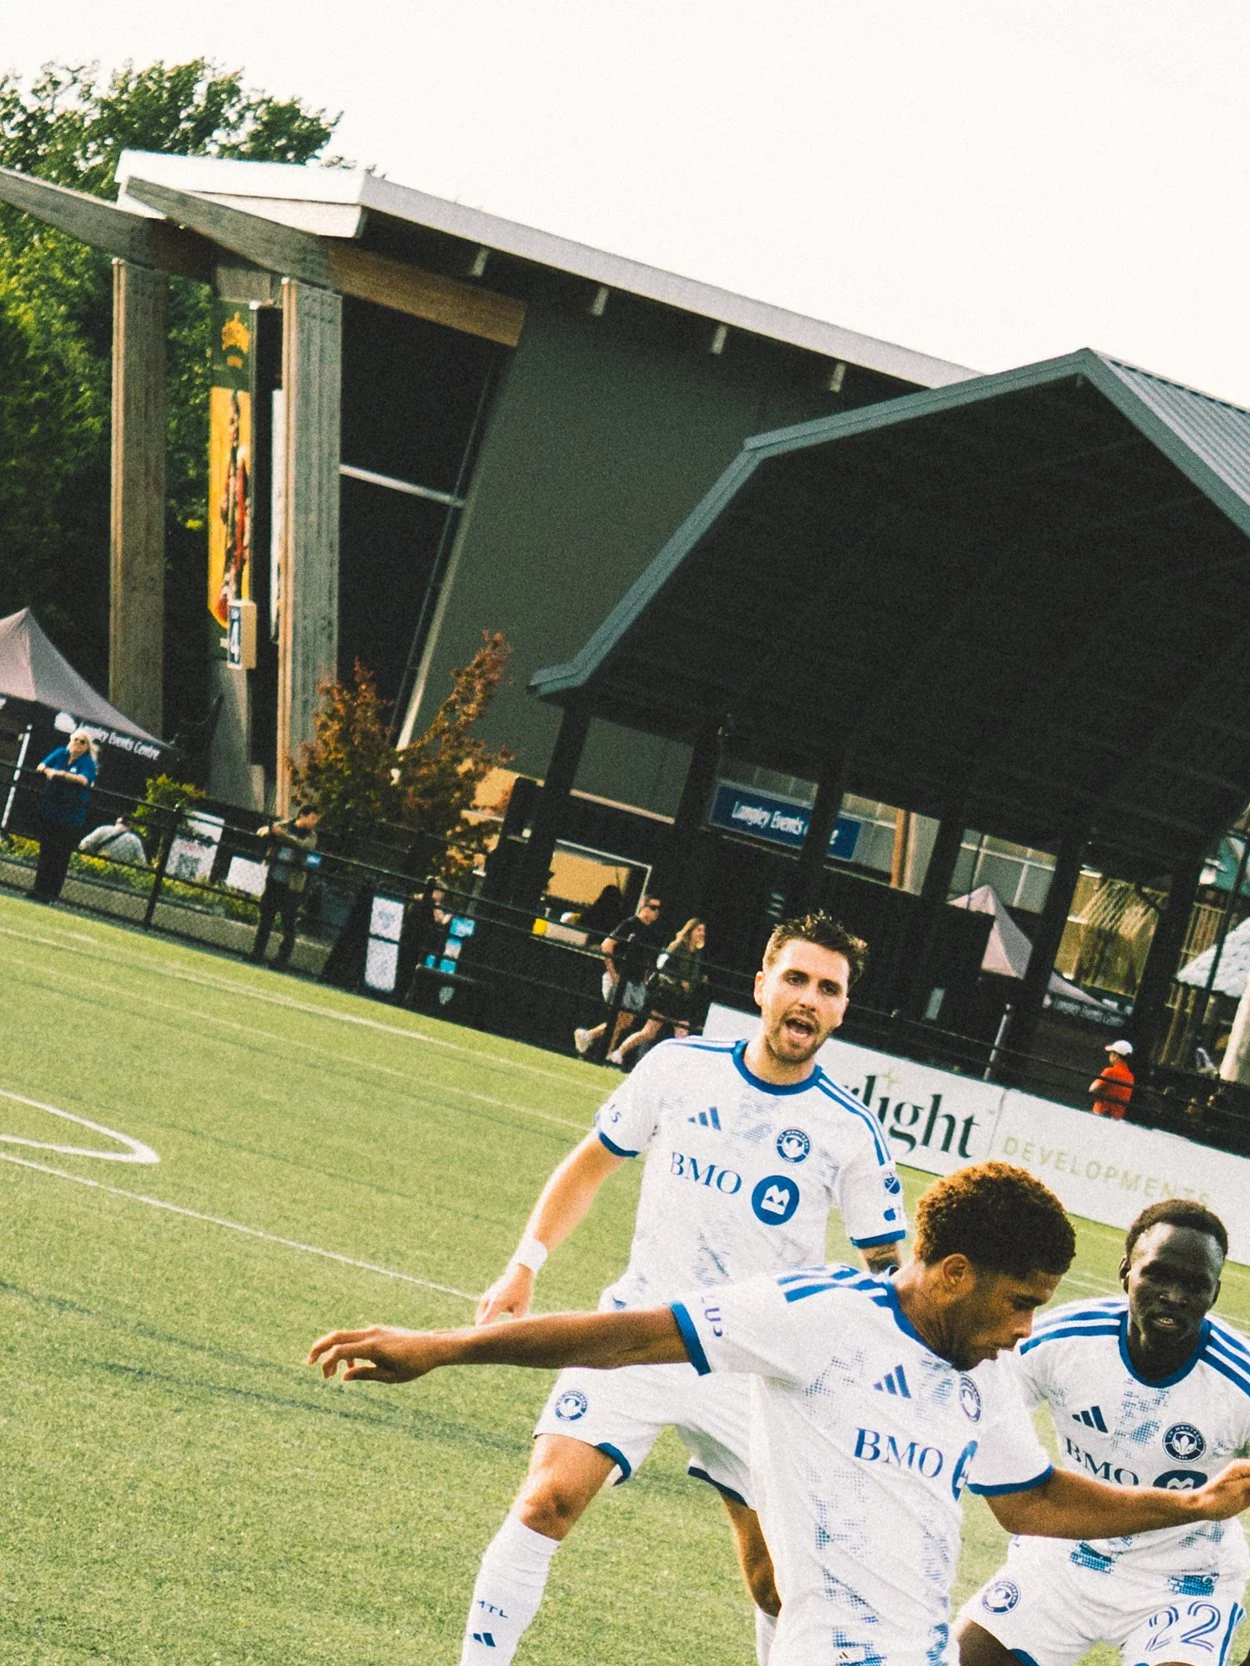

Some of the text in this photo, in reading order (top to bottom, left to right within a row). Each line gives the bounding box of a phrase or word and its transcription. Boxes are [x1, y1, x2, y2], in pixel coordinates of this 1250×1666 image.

[770, 811, 804, 836] Events
[670, 1151, 743, 1195] BMO
[854, 1427, 944, 1479] BMO
[1065, 1437, 1140, 1487] BMO
[1144, 1600, 1222, 1653] 22
